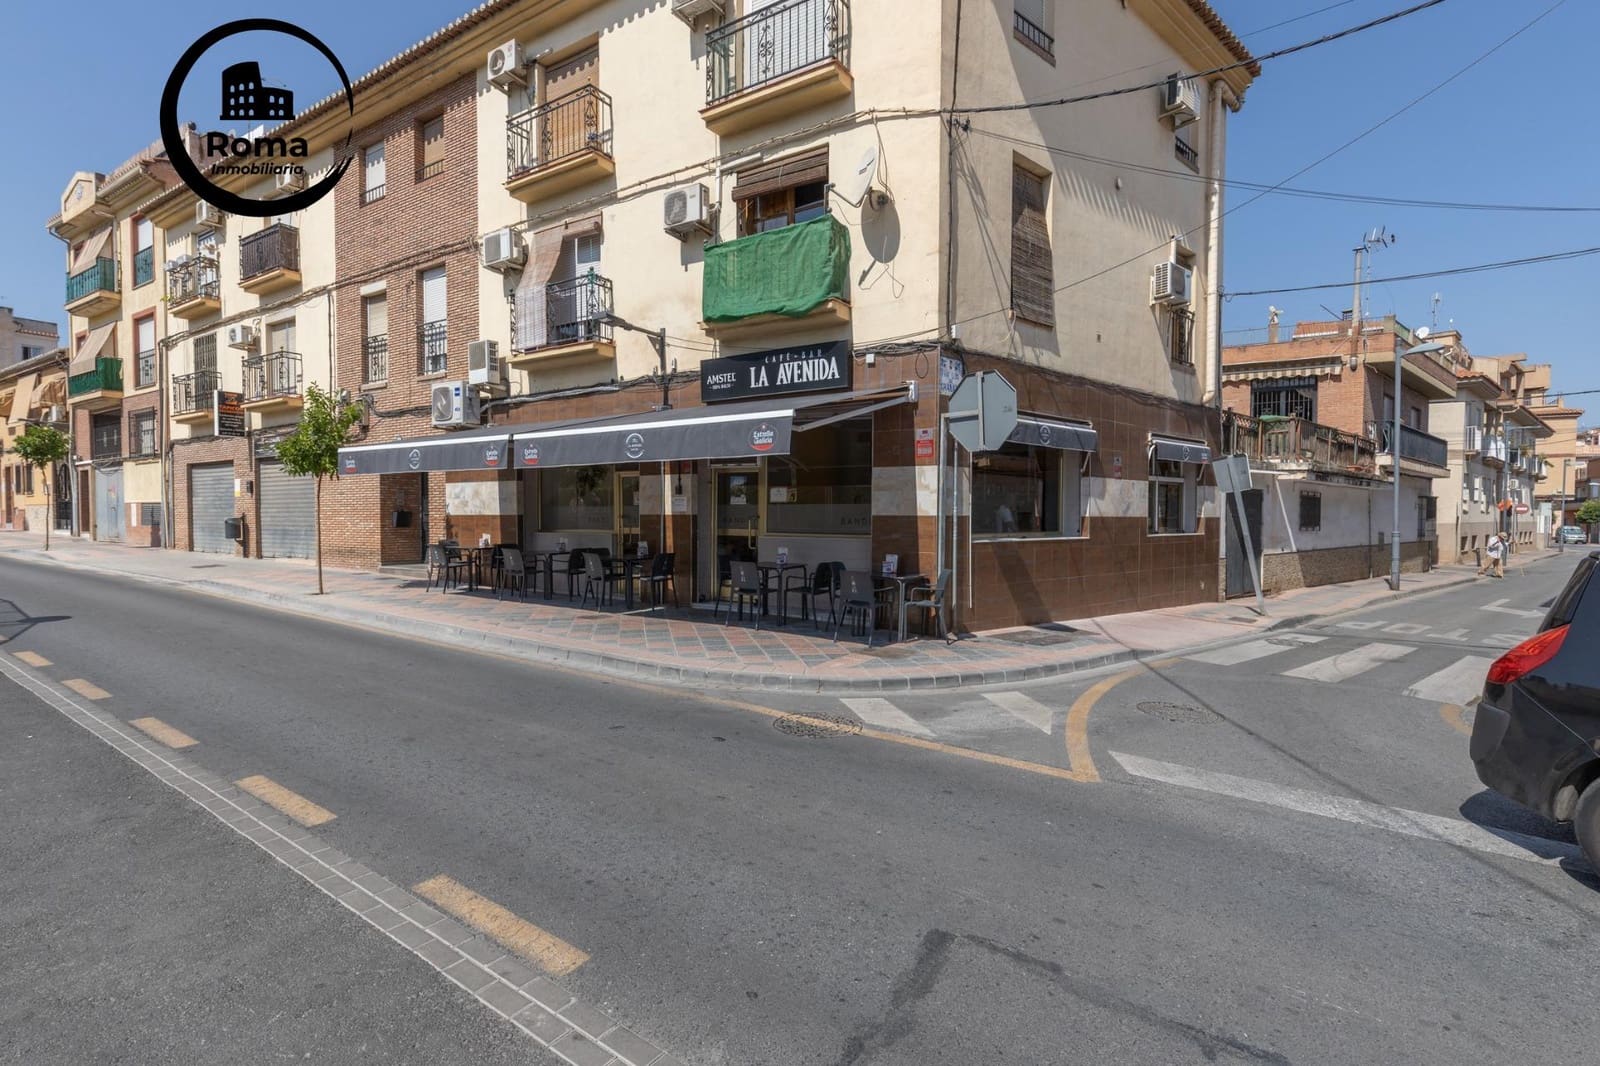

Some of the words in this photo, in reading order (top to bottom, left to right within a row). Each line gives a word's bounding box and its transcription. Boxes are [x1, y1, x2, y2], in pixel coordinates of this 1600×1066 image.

[707, 372, 736, 385] AMSTEL
[750, 366, 769, 388] LA
[776, 356, 840, 385] AVENIDA
